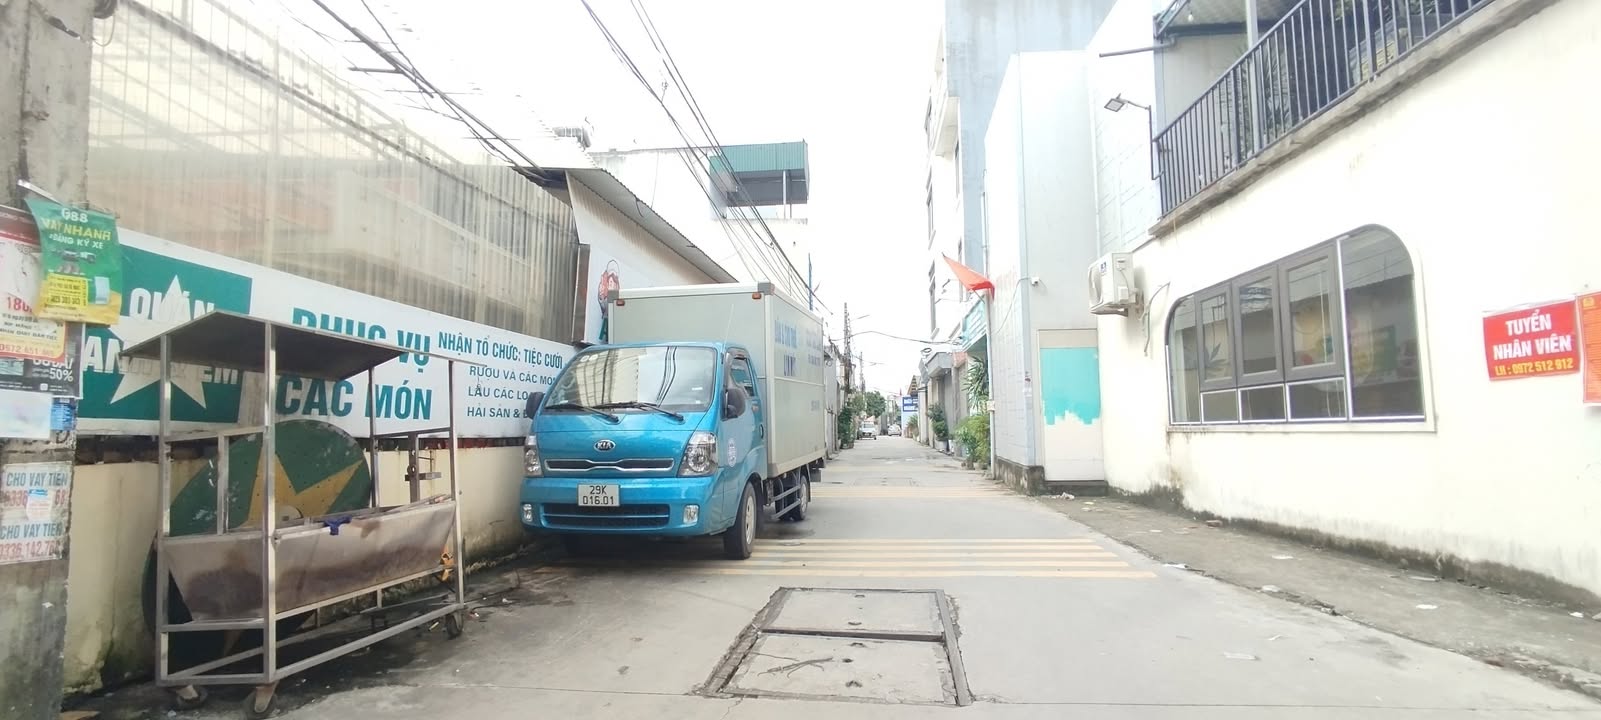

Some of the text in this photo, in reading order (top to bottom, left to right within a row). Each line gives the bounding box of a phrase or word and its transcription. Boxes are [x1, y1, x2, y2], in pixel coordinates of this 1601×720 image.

[63, 223, 112, 240] NHANH
[92, 240, 104, 249] XE
[1505, 309, 1552, 336] TUYỂN
[397, 329, 431, 373] VỤ
[438, 331, 473, 356] NHẬN
[476, 335, 489, 356] TỔ
[524, 347, 542, 368] TIỆC
[1493, 333, 1572, 360] NHÂN VIÊN
[1535, 360, 1553, 372] 512
[1555, 357, 1574, 370] 912
[49, 367, 74, 382] 50%
[365, 380, 432, 420] MÓN
[513, 409, 521, 419] &
[597, 440, 612, 449] KIA
[6, 473, 26, 487] CHO
[29, 472, 47, 487] VAY
[589, 486, 607, 495] 29K
[582, 496, 614, 505] 016.01
[0, 525, 20, 540] CHO
[23, 523, 41, 538] VAY
